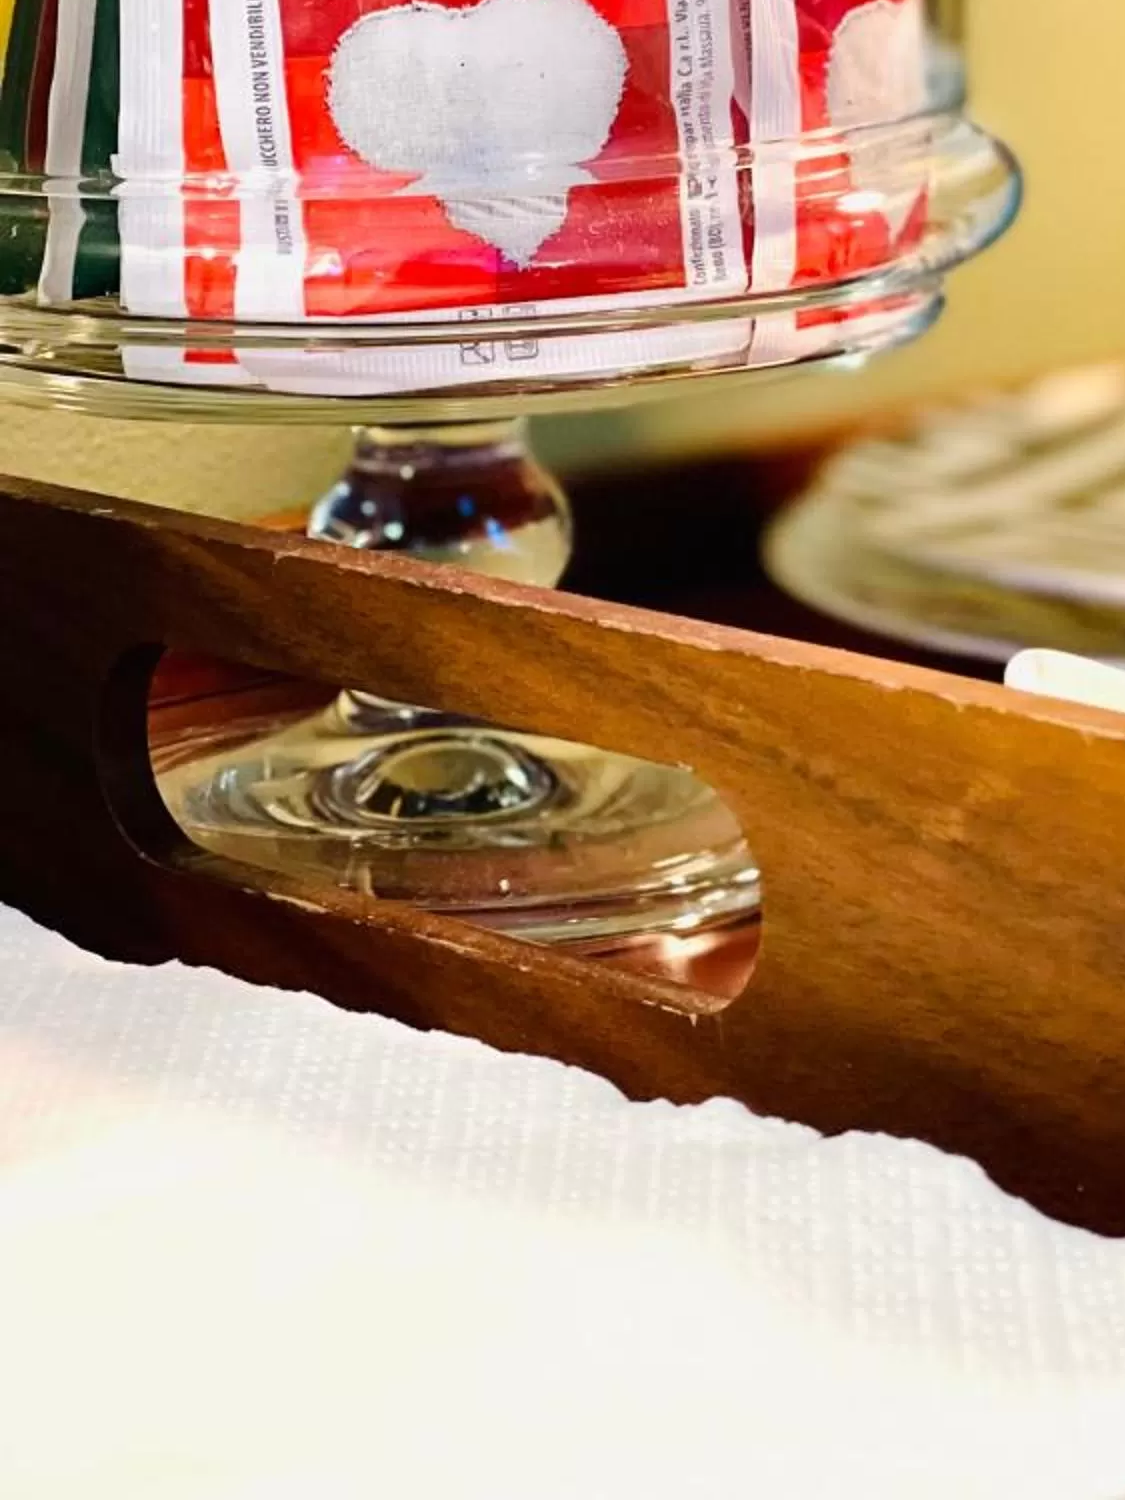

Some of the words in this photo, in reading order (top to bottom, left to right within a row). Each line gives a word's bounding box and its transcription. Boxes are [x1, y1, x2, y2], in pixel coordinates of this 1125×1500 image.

[674, 0, 688, 23] Via
[252, 70, 271, 105] NON
[256, 105, 278, 168] UCCHERO
